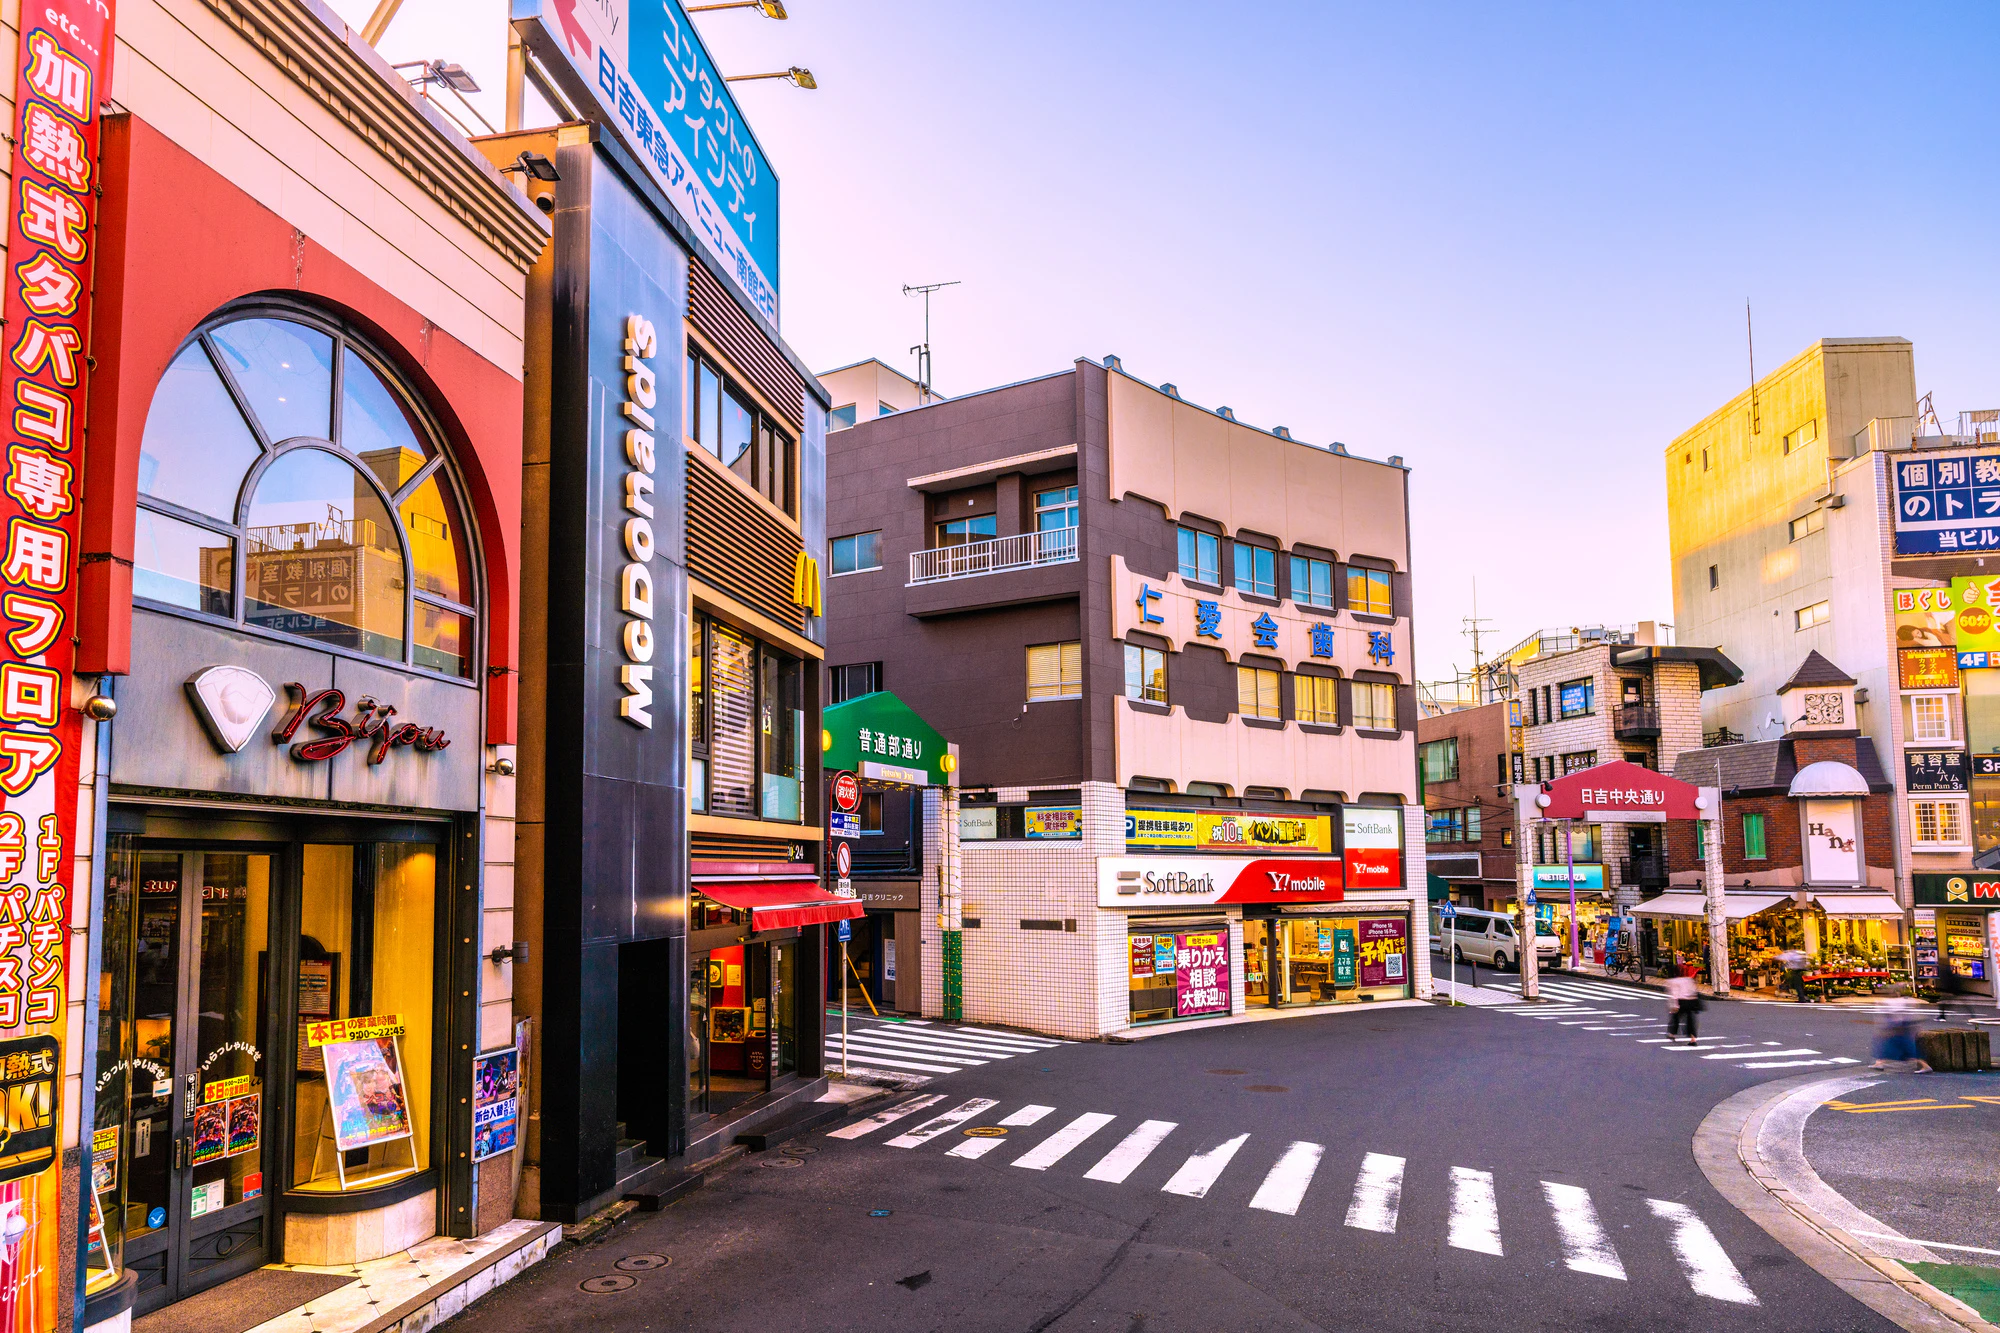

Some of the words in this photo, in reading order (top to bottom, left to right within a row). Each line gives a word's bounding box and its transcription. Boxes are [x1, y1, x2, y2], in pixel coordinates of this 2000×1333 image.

[2, 38, 88, 790] 加熱式タバコ専用フロア
[621, 314, 657, 729] McDonald's
[1939, 529, 2000, 548] 当ビル
[1898, 590, 1951, 611] ほぐし
[1136, 582, 1395, 666] 仁愛会歯科
[1960, 614, 1991, 627] 60分
[1960, 653, 1985, 666] 4F
[272, 682, 451, 765] Bijou
[858, 727, 922, 760] 普通部通り
[1910, 753, 1961, 767] 美容室
[838, 785, 856, 800] 消火栓
[1581, 788, 1665, 805] 日吉中央通り
[963, 819, 993, 827] SoftBank
[1036, 812, 1075, 821] 料金相談会
[1357, 823, 1393, 834] SoftBank
[1809, 823, 1855, 852] Hana
[795, 844, 804, 860] 24
[1145, 870, 1215, 894] SoftBank
[1177, 946, 1227, 969] 乗りかえ
[1337, 957, 1351, 966] スマホ
[1360, 937, 1395, 966] 予約
[1189, 968, 1217, 989] 相談
[1337, 966, 1352, 976] 教室
[1181, 988, 1226, 1010] 大歓迎!!
[310, 1021, 347, 1042] 本日
[0, 1048, 54, 1081] 熱式
[202, 1041, 262, 1071] いらっしゃいませ
[205, 1081, 224, 1102] 本日
[0, 1264, 46, 1304] ijou
